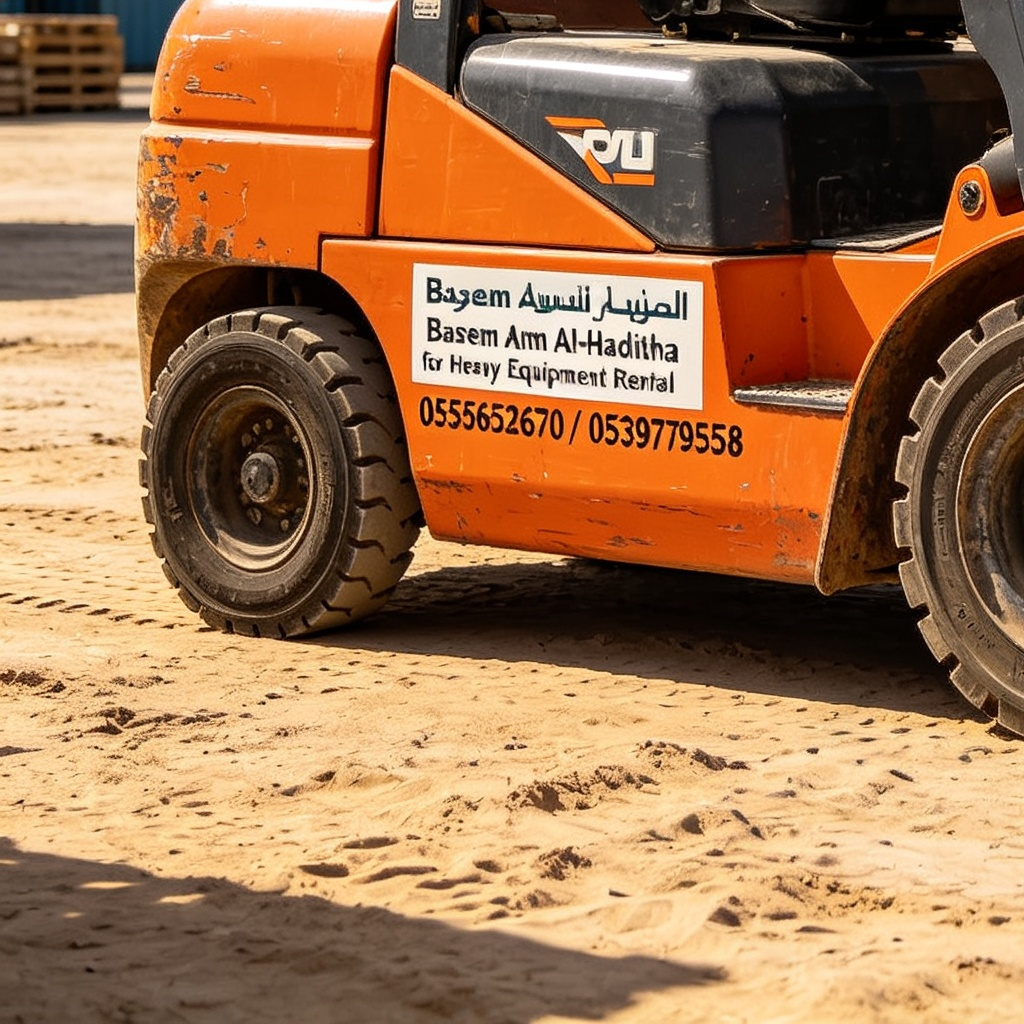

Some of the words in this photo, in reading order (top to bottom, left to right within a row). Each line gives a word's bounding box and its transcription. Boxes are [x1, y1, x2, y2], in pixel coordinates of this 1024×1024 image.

[427, 316, 498, 347] Basem
[553, 327, 678, 363] Al-Haditha
[508, 358, 607, 389] Equipment
[613, 367, 674, 393] Rental
[419, 396, 564, 440] 0555652670
[589, 412, 743, 457] 0539779558
